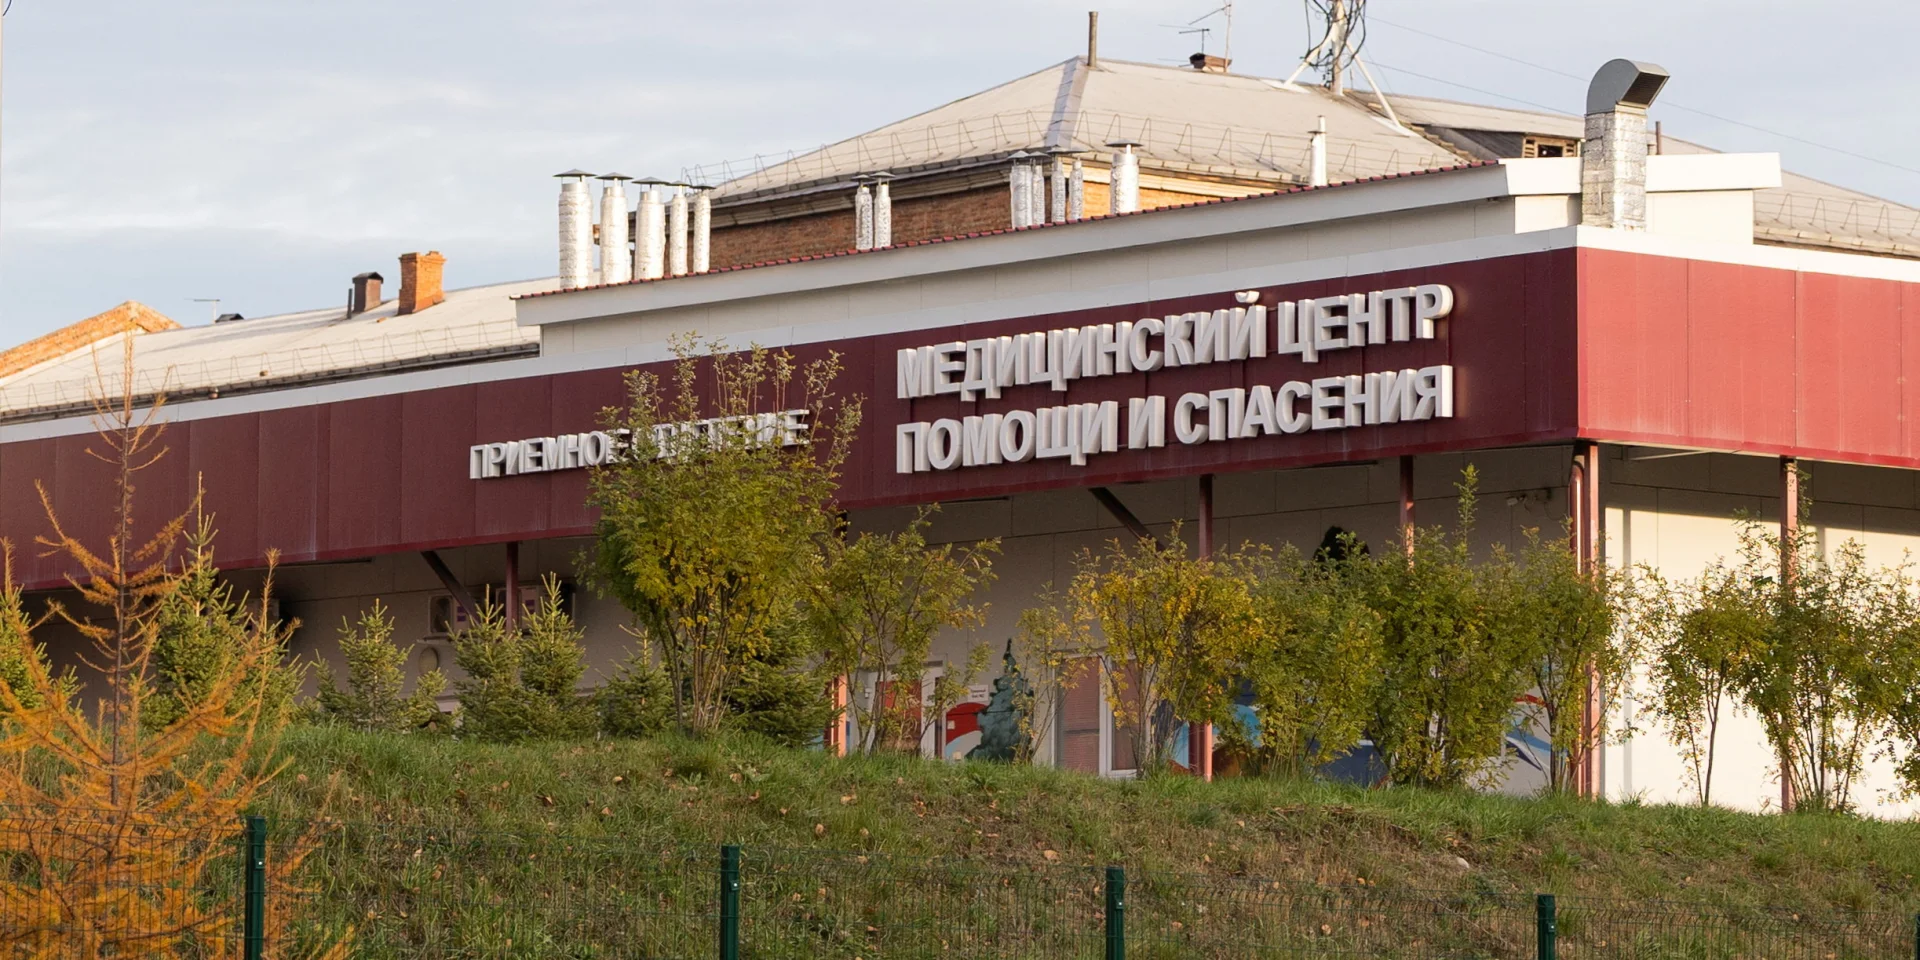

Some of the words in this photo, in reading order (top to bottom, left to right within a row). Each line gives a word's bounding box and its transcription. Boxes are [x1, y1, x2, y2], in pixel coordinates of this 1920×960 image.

[897, 290, 1267, 401] МЕДИЦИНСКИЙ
[1277, 284, 1453, 363] ЦЕНТР
[470, 428, 630, 479] ПРИЕМНОЕ
[897, 401, 1119, 473] ПОМОЩИ
[1128, 395, 1165, 449] И
[1174, 364, 1453, 444] СПАСЕНИЯ
